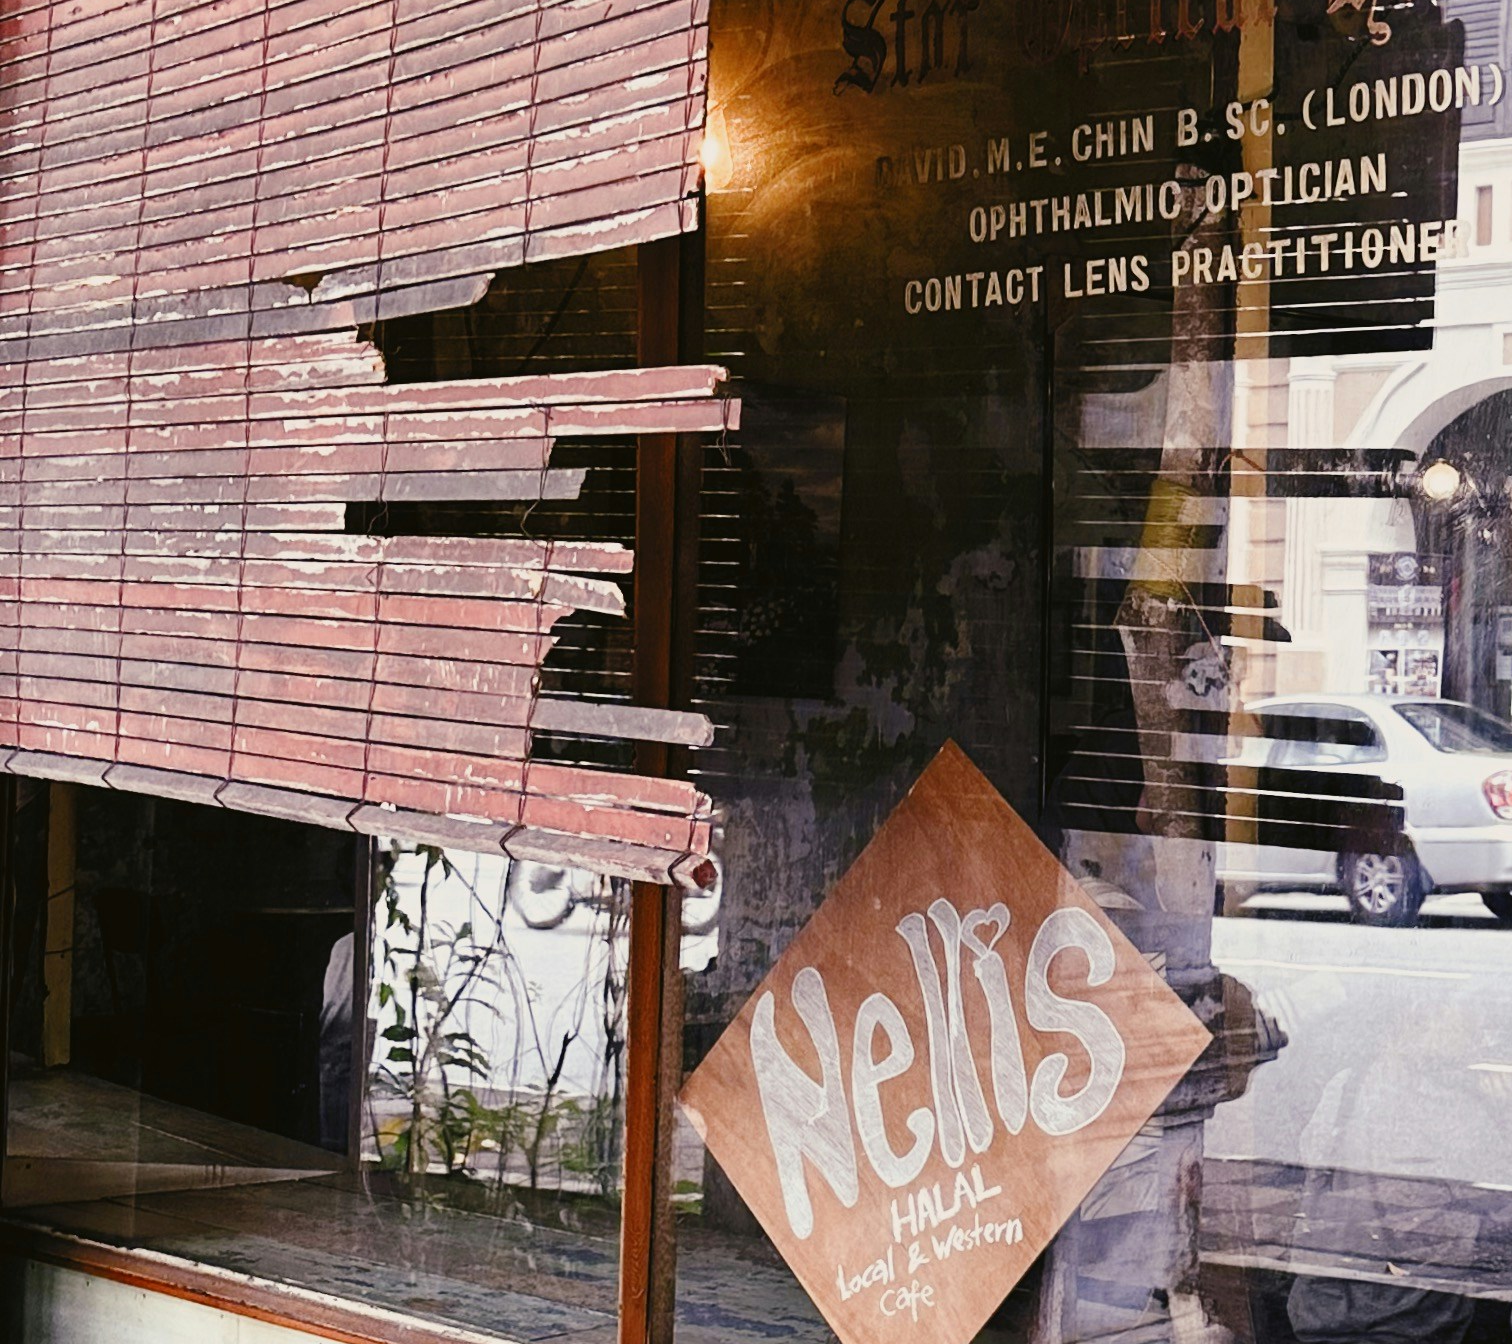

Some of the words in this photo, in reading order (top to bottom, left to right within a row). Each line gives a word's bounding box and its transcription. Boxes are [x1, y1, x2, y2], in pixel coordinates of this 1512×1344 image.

[1302, 63, 1504, 131] (LONDON)
[969, 179, 1182, 244] OPHTHALMIC
[1204, 153, 1388, 214] OPTICIAN
[904, 265, 1044, 315] CONTACT
[1063, 254, 1150, 299] LENS
[1171, 219, 1472, 288] PRACTITIONER
[890, 1164, 1002, 1243] HALAL
[836, 1250, 896, 1302] Local
[907, 1243, 930, 1271] &
